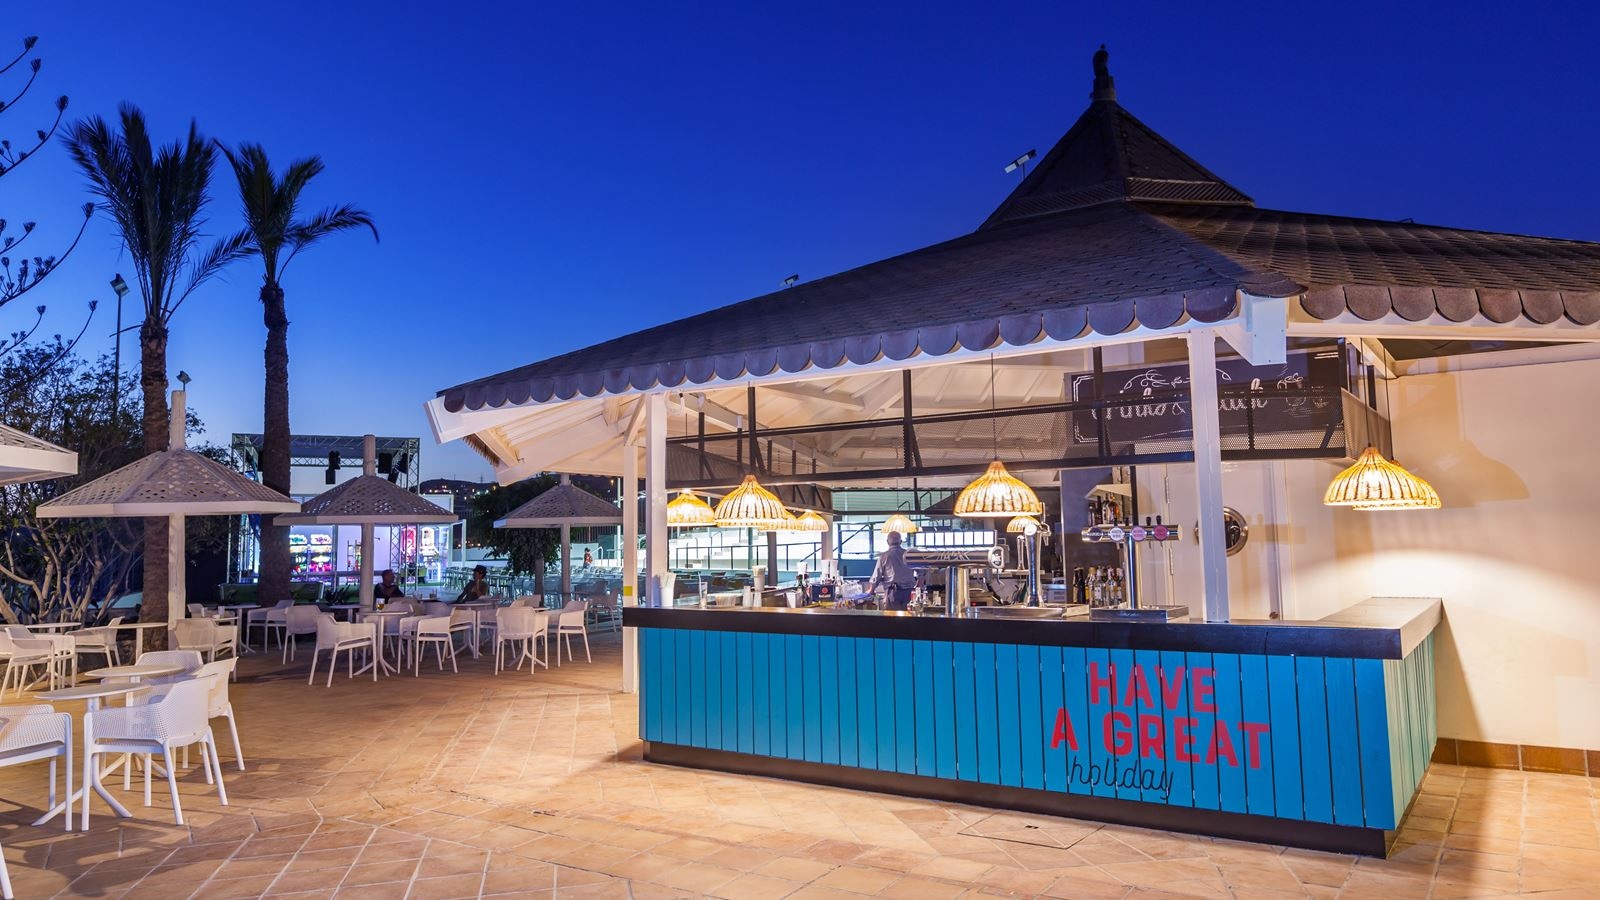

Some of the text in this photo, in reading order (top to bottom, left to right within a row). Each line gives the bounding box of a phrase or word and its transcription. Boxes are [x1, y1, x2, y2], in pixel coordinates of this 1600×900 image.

[1089, 661, 1219, 713] HAVE
[1050, 707, 1270, 769] A GREAT
[1070, 755, 1174, 800] holiday
